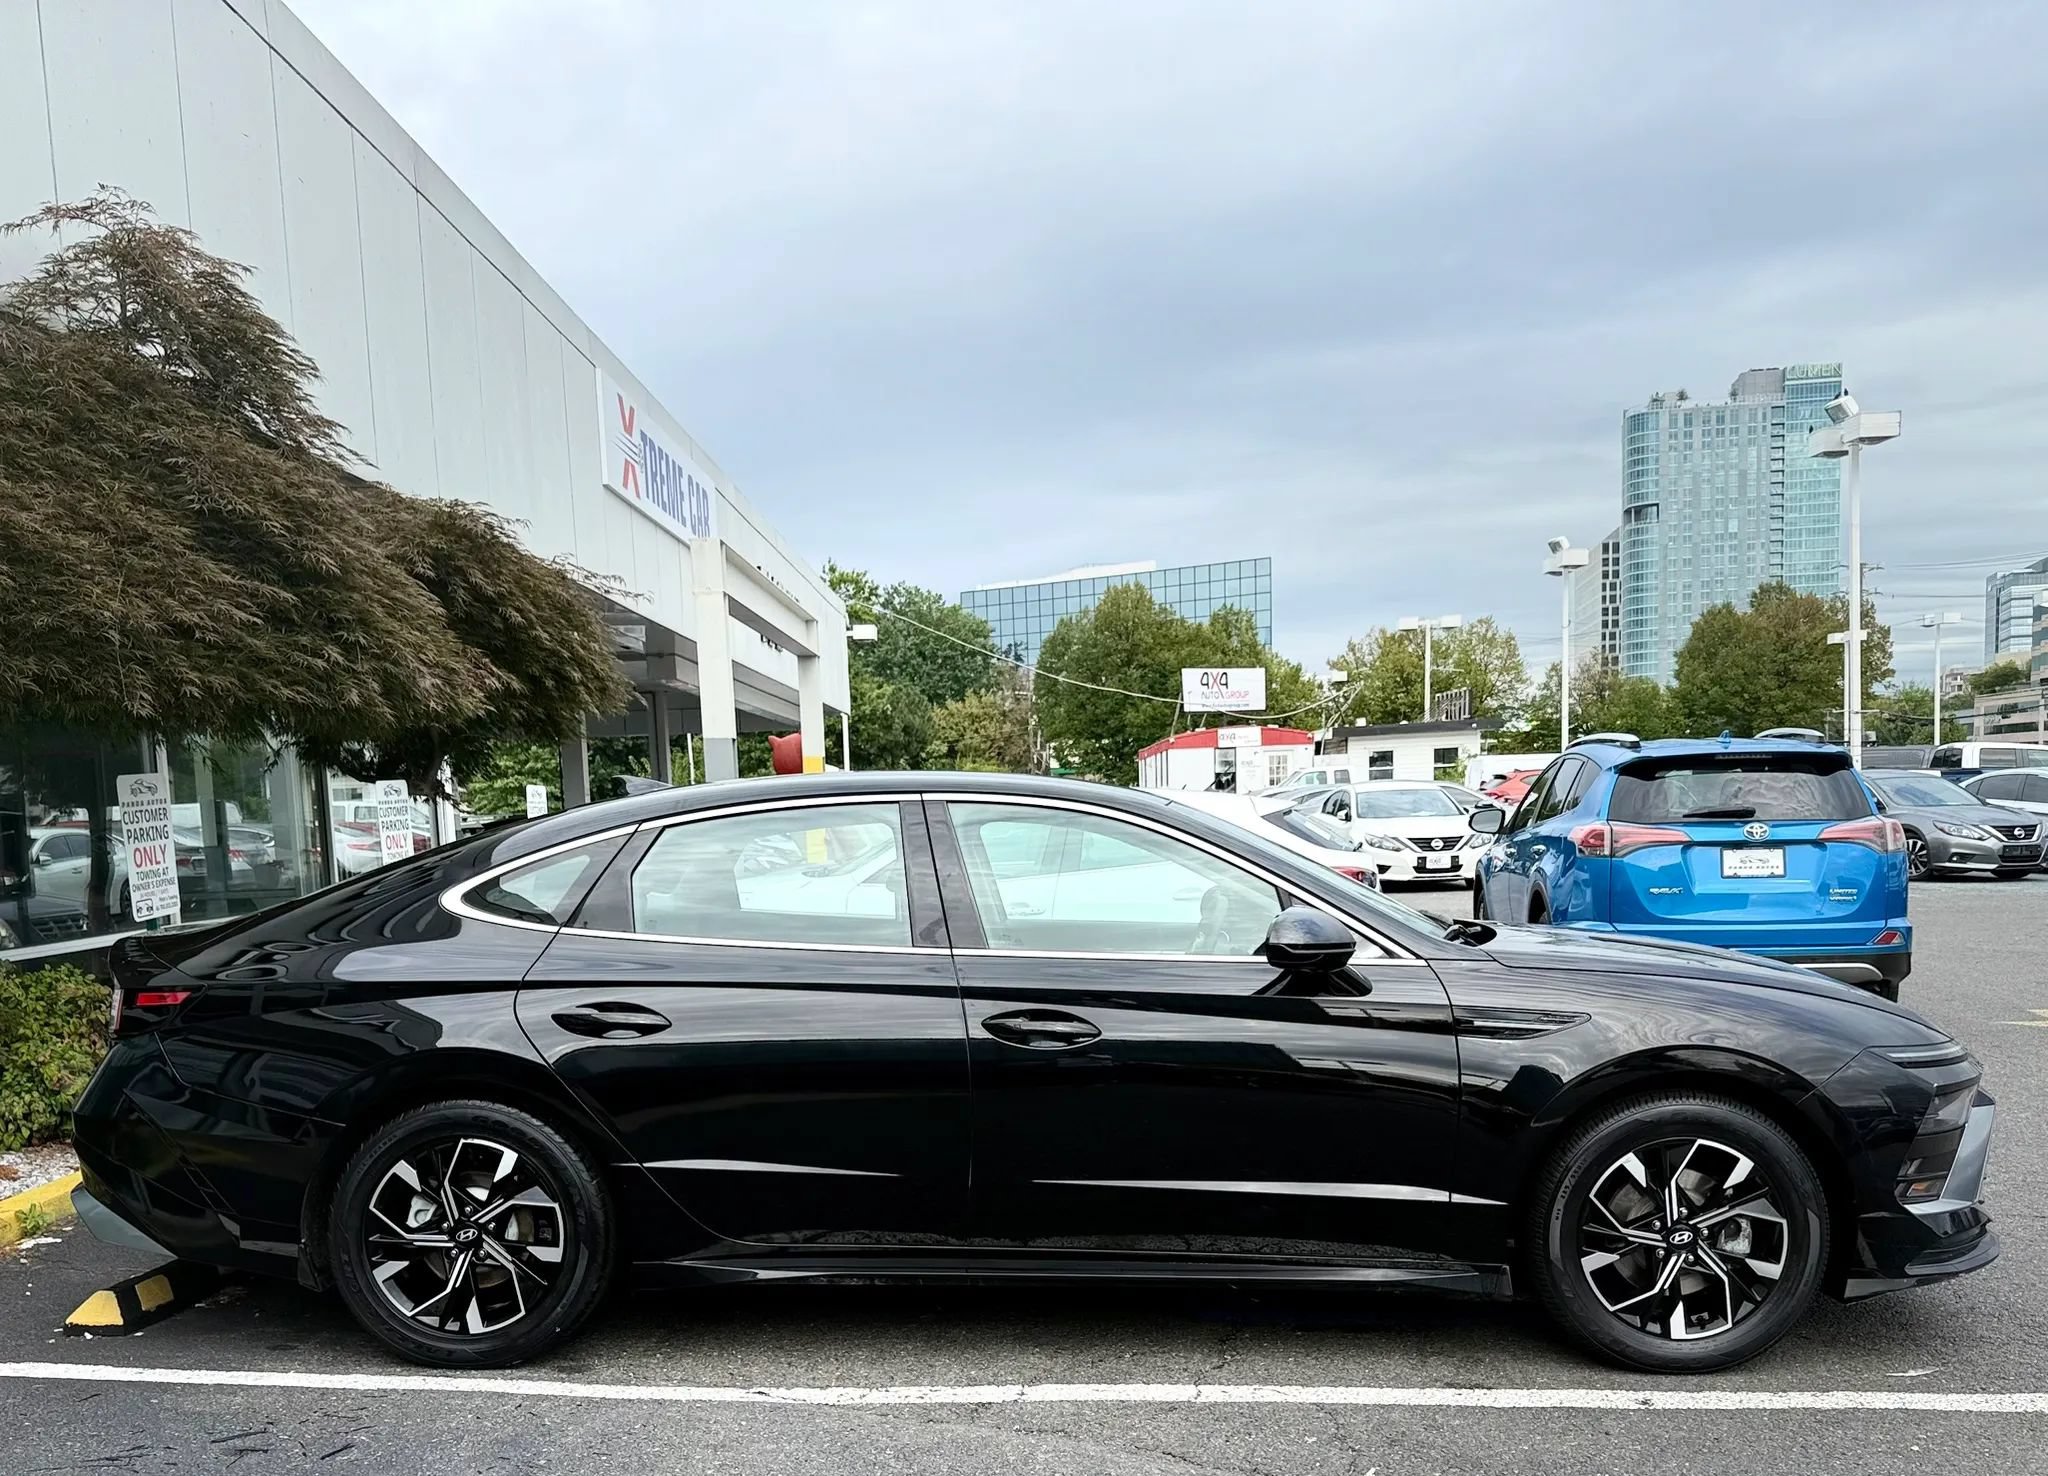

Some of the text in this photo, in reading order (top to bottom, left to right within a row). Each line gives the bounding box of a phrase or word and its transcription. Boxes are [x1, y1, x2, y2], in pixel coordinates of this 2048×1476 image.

[1787, 363, 1842, 378] LUMEN
[688, 473, 711, 540] CAR
[1201, 690, 1249, 699] AUTO GROUP
[122, 807, 169, 825] CUSTOMER
[378, 805, 409, 818] CUSTOMER
[381, 818, 410, 832] PARKING
[126, 824, 170, 845] PARKING
[385, 833, 408, 850] ONLY
[133, 844, 167, 868] ONLY
[387, 851, 403, 860] TOWING
[136, 867, 169, 882] TOWING AT
[155, 877, 176, 888] EXPENSE
